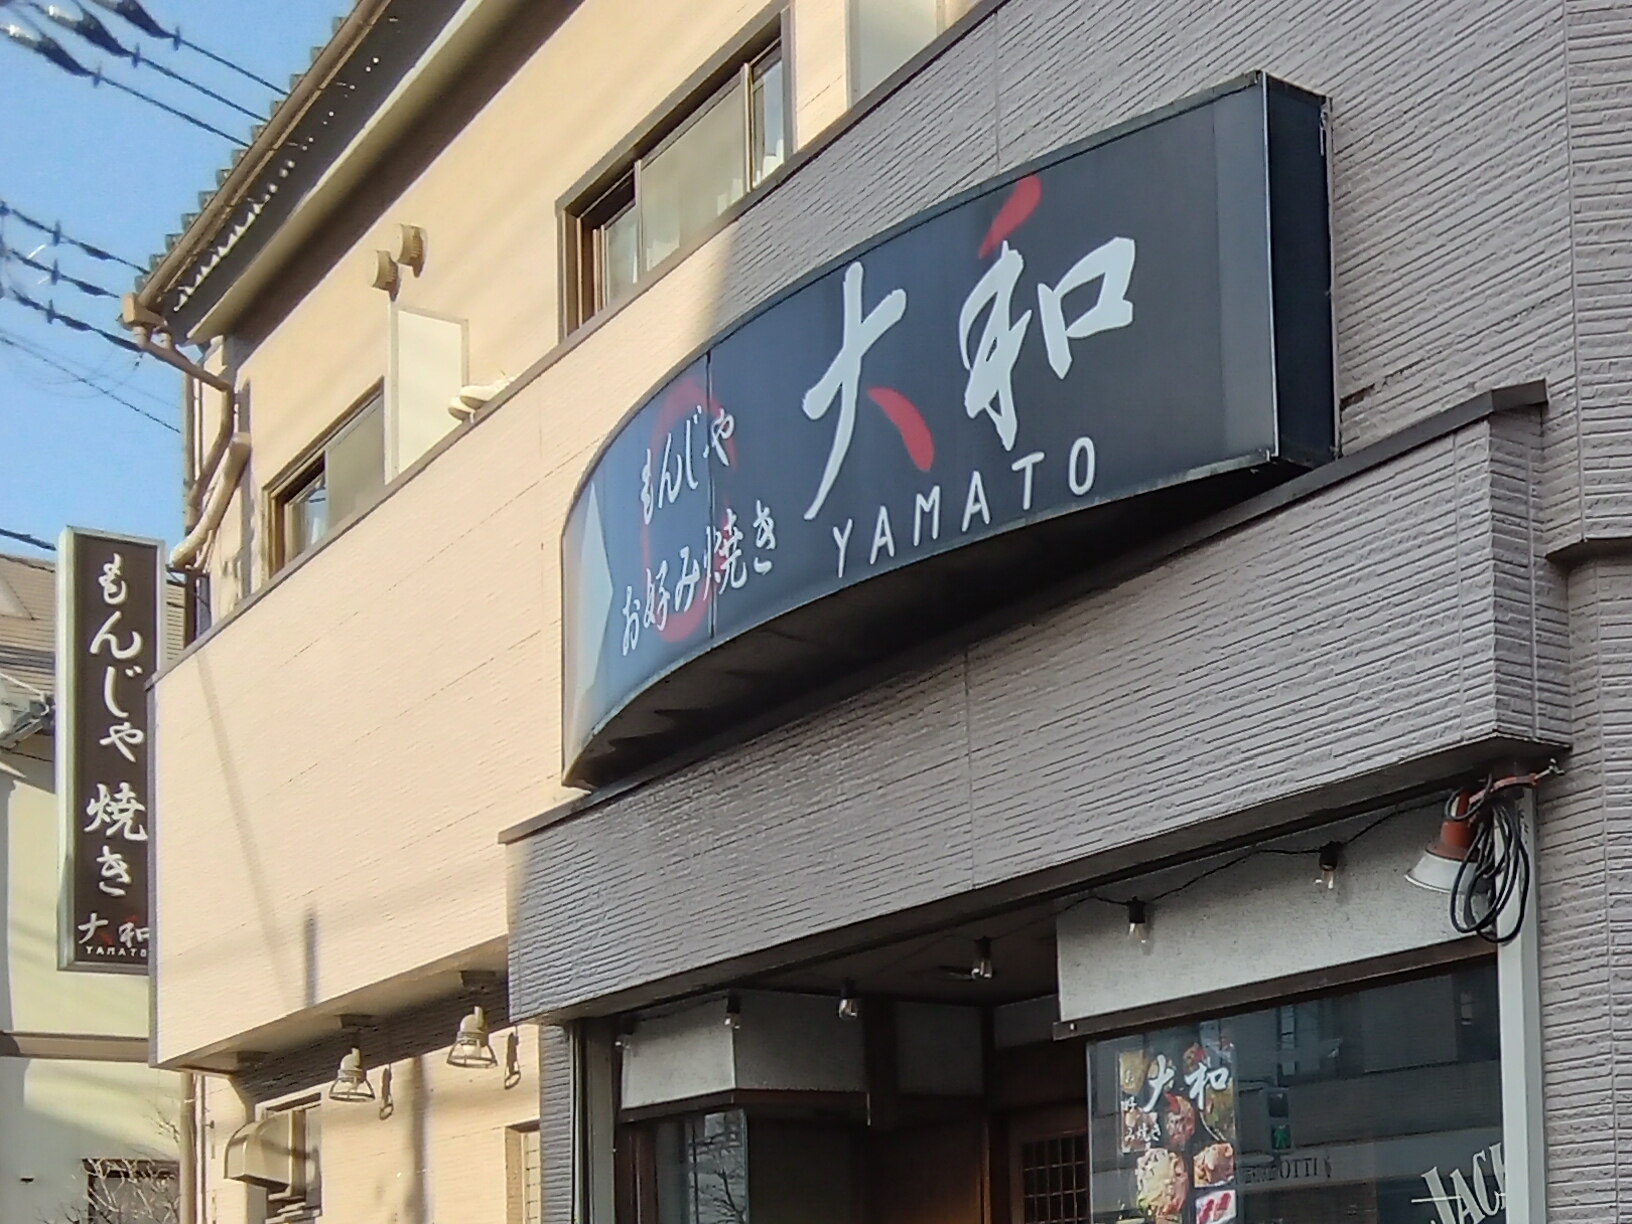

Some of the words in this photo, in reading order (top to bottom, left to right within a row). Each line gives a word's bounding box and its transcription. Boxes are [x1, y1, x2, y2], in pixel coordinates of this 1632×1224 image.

[802, 172, 1135, 520] 大和
[832, 436, 1096, 578] YAMATO
[623, 500, 777, 656] お好み焼き
[78, 912, 149, 948] 大和
[86, 946, 147, 957] YAMATO
[1143, 1054, 1230, 1114] 大和
